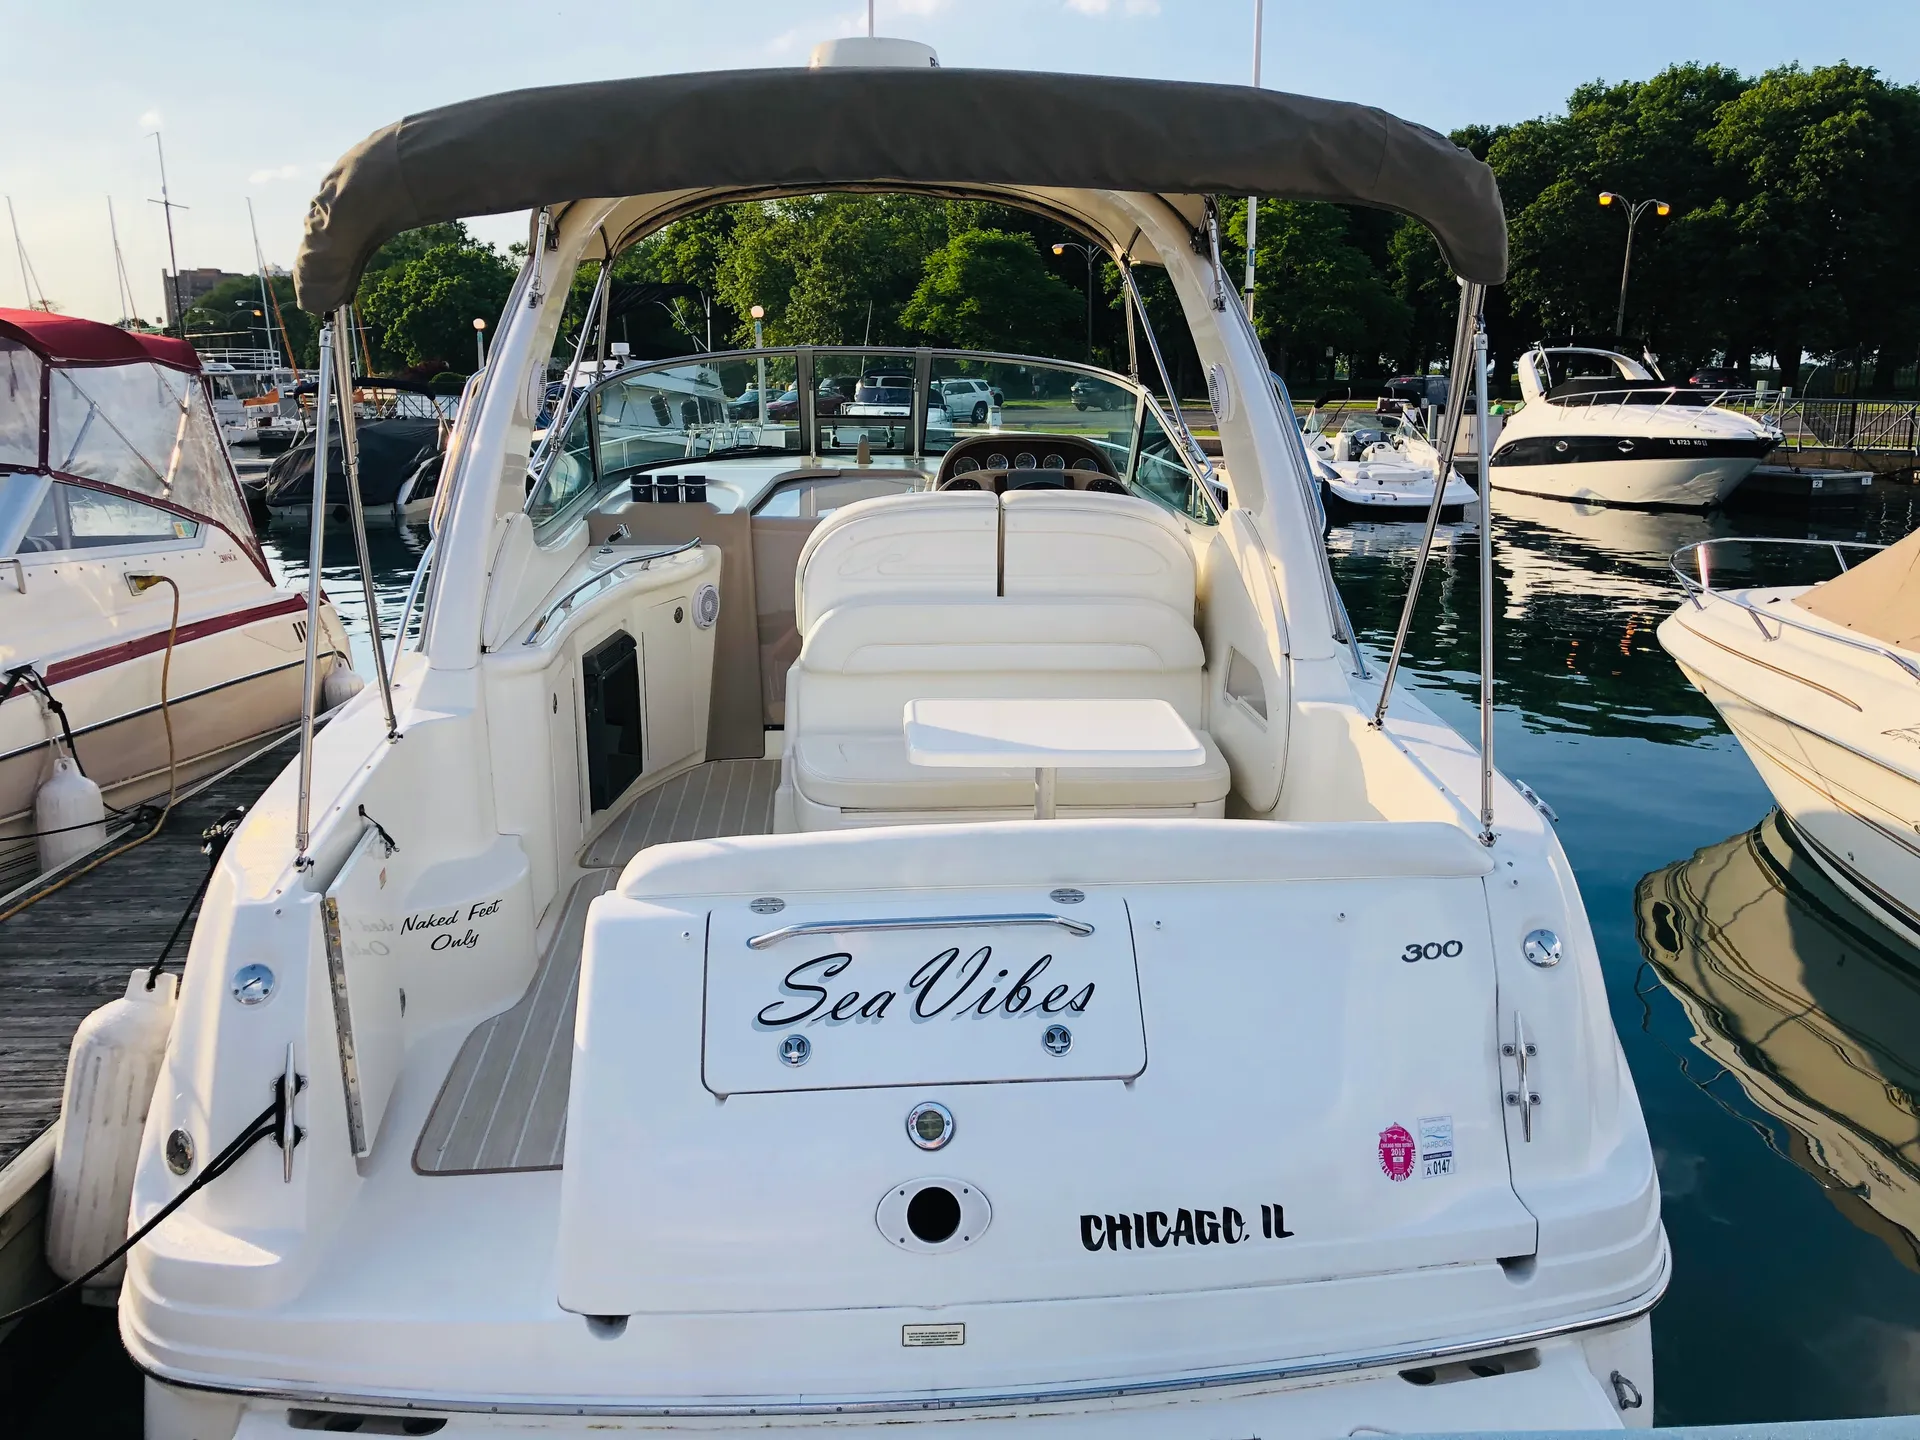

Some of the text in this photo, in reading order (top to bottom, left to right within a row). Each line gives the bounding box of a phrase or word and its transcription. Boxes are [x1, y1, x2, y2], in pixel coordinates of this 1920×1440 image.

[401, 899, 503, 935] Naked Feet
[430, 929, 480, 951] Only
[1401, 939, 1463, 963] 300
[757, 945, 1096, 1026] Sea Vibes
[1420, 1125, 1452, 1135] CHICAGO
[1422, 1138, 1452, 1149] HARBORS
[1426, 1166, 1432, 1176] A
[1433, 1159, 1451, 1175] 0147
[1261, 1203, 1295, 1239] IL
